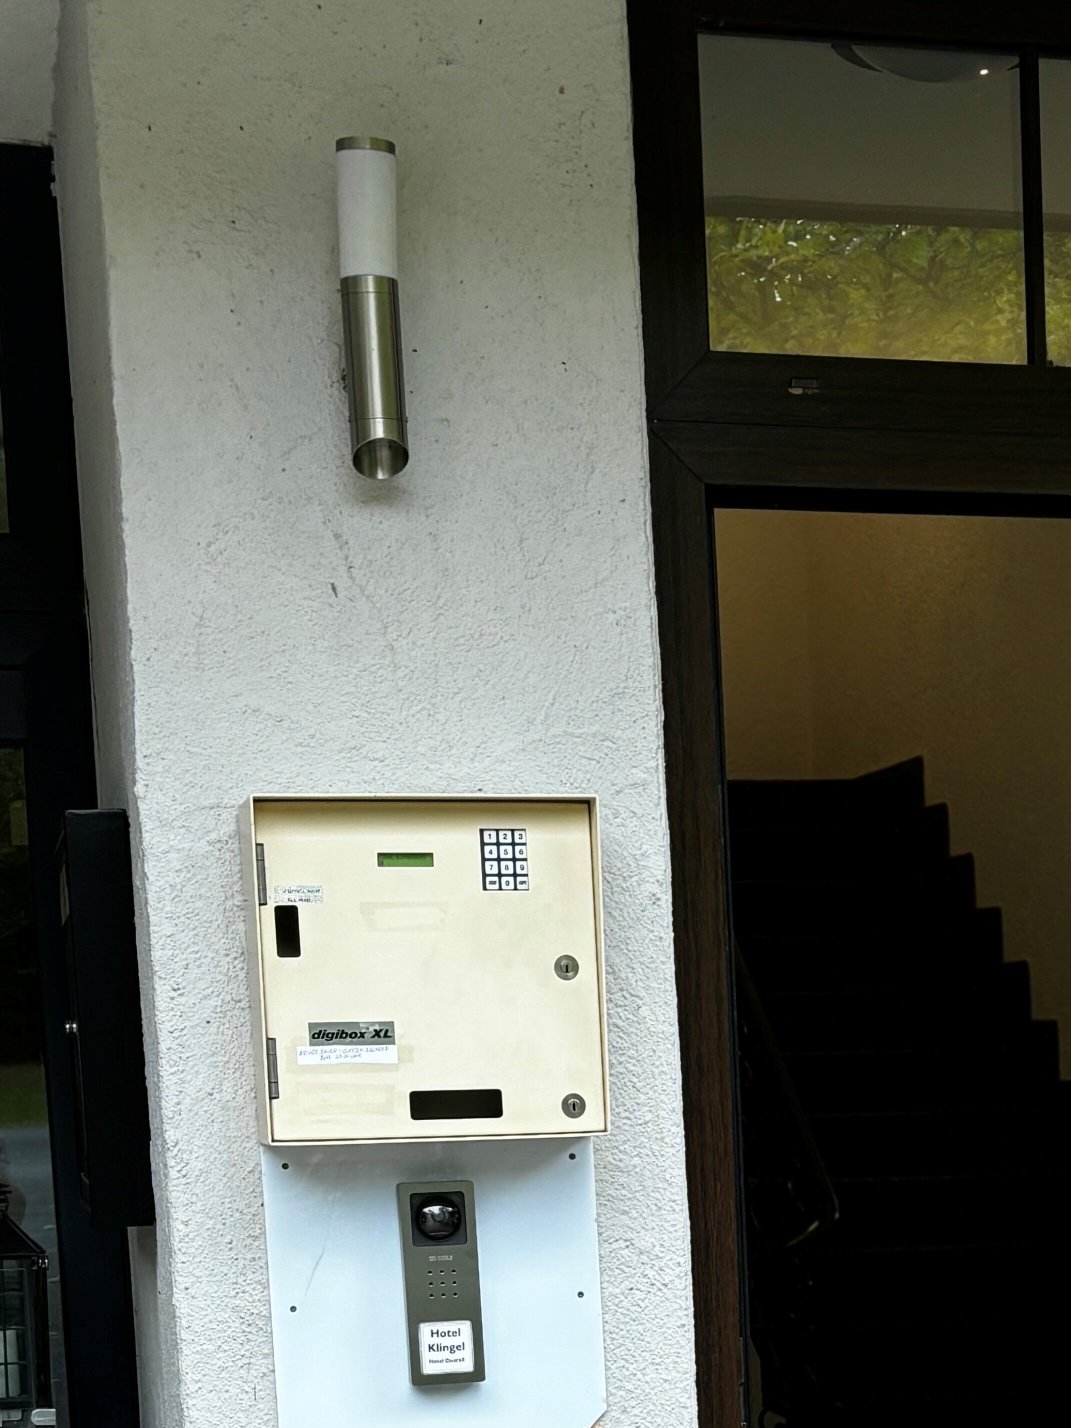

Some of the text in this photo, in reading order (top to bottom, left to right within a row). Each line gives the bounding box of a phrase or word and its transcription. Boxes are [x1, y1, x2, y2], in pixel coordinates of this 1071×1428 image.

[312, 1028, 393, 1042] digibox XL
[430, 1328, 461, 1338] Hotel
[428, 1342, 465, 1354] Klingel
